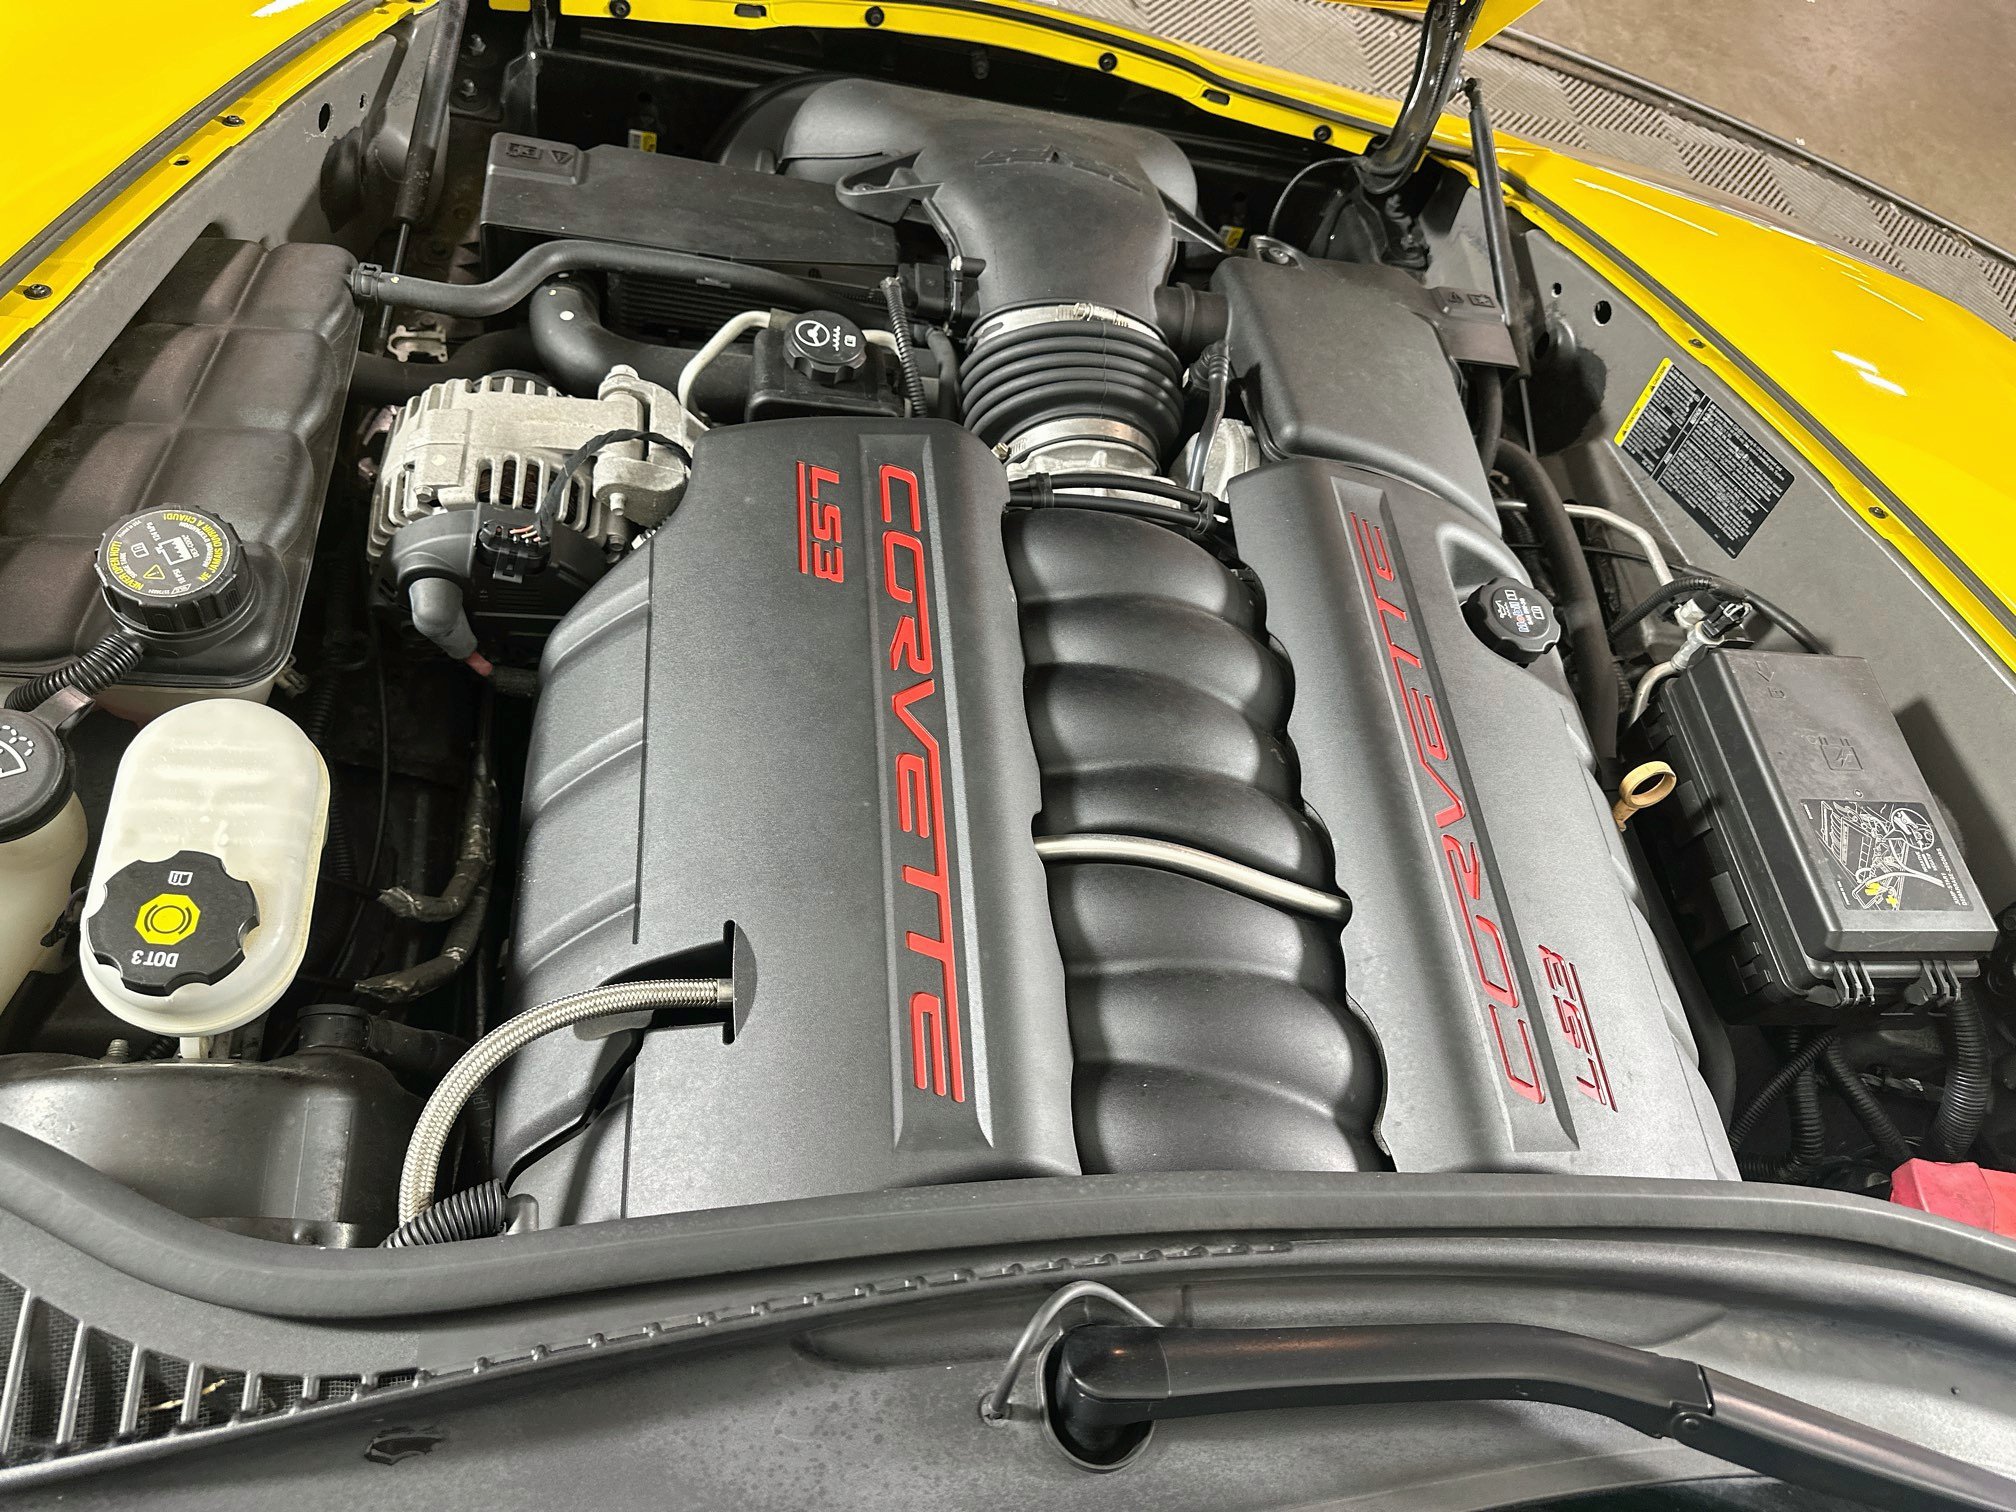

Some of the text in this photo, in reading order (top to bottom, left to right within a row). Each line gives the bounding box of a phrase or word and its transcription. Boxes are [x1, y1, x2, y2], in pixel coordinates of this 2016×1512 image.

[163, 513, 197, 523] CHAUD!
[807, 464, 844, 583] LS3
[202, 524, 223, 547] OUVRIR
[109, 540, 144, 591] NEVER OPEN HOT!
[208, 547, 224, 573] JAMAIS
[197, 571, 213, 582] NE
[1509, 601, 1530, 632] Mobil
[879, 463, 965, 1103] CORVETTE
[1347, 511, 1546, 1104] CORVETTE
[131, 950, 179, 968] DOT 3
[1537, 944, 1607, 1106] LS3
